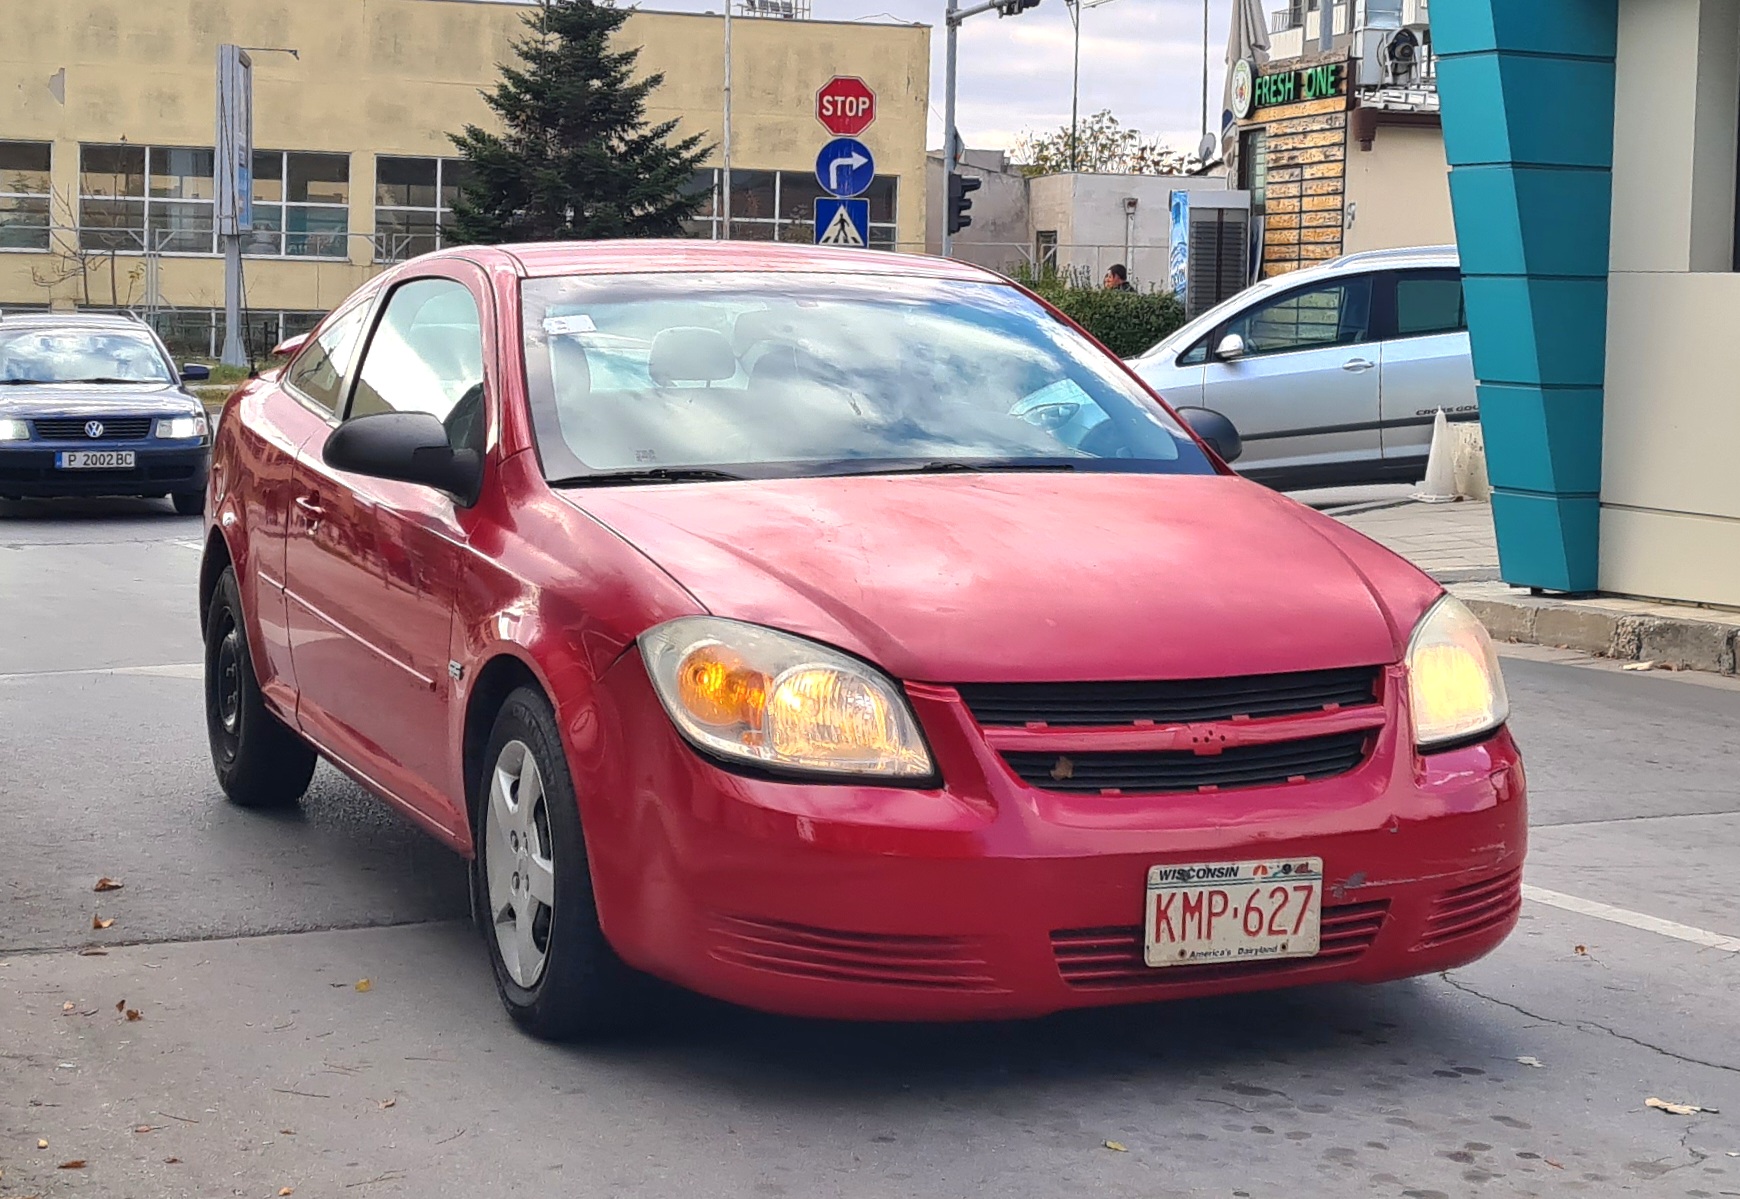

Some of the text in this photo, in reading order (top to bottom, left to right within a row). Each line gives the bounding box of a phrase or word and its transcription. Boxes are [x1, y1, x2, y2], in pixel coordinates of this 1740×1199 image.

[1255, 72, 1294, 106] FRESH
[1306, 65, 1336, 98] ONE
[822, 95, 869, 116] STOP
[1159, 866, 1239, 881] WISCONSIN
[1189, 946, 1278, 959] America's Dairyland
